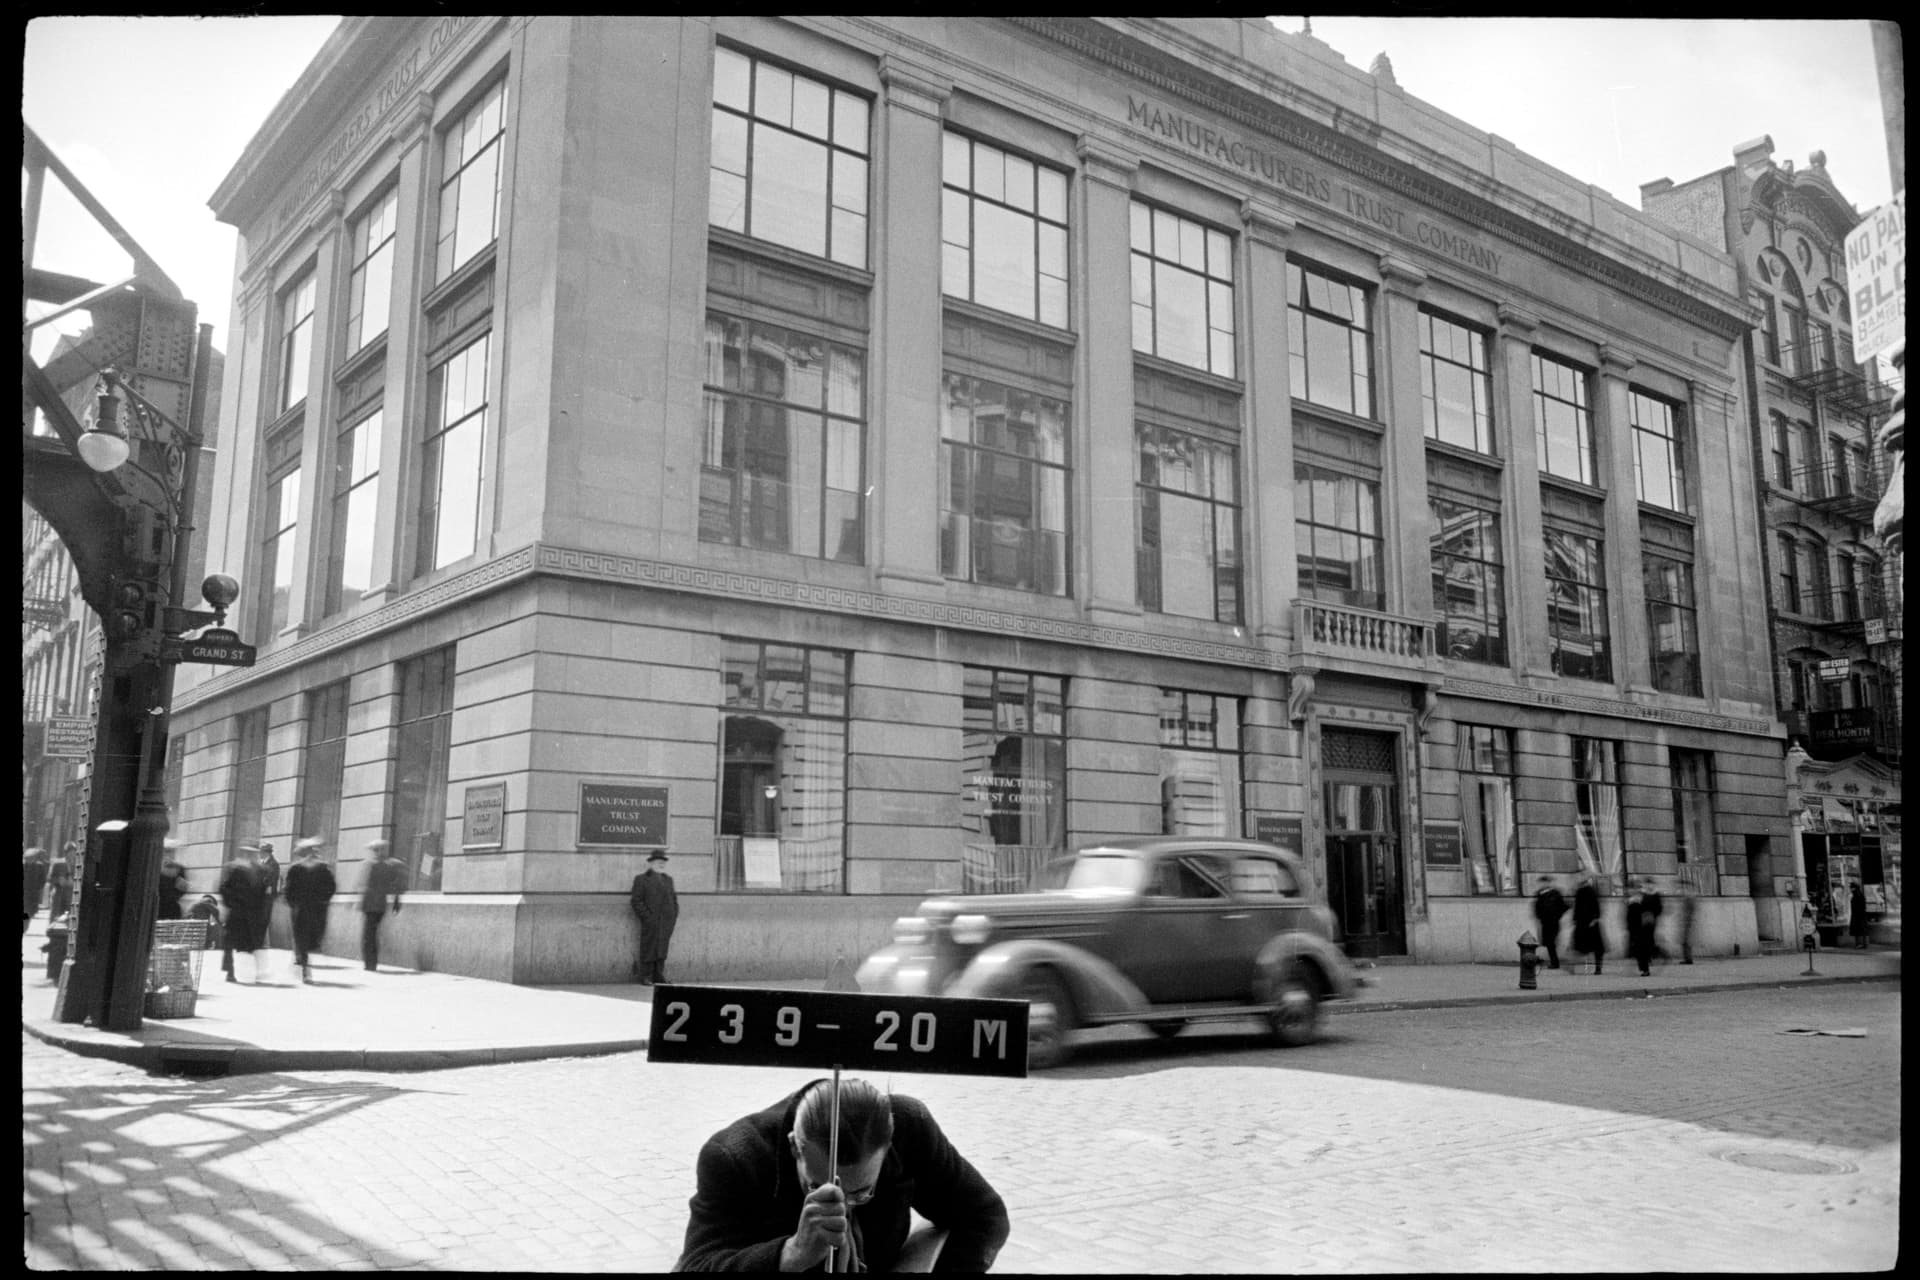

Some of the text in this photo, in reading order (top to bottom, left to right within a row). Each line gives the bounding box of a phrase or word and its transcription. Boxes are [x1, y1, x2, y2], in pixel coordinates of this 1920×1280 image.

[376, 47, 422, 114] TRUST
[1126, 95, 1503, 275] MANUFACTURERS TRUST COMPANY
[1848, 231, 1871, 271] NO
[1870, 250, 1888, 276] IN
[192, 647, 228, 659] GRAND
[1836, 727, 1871, 738] MONTH
[973, 775, 1054, 789] MANUFACTURERS
[586, 796, 665, 808] MANUFACTURERS
[610, 811, 641, 820] TRUST
[601, 824, 648, 834] COMPANY
[972, 1018, 1007, 1060] M
